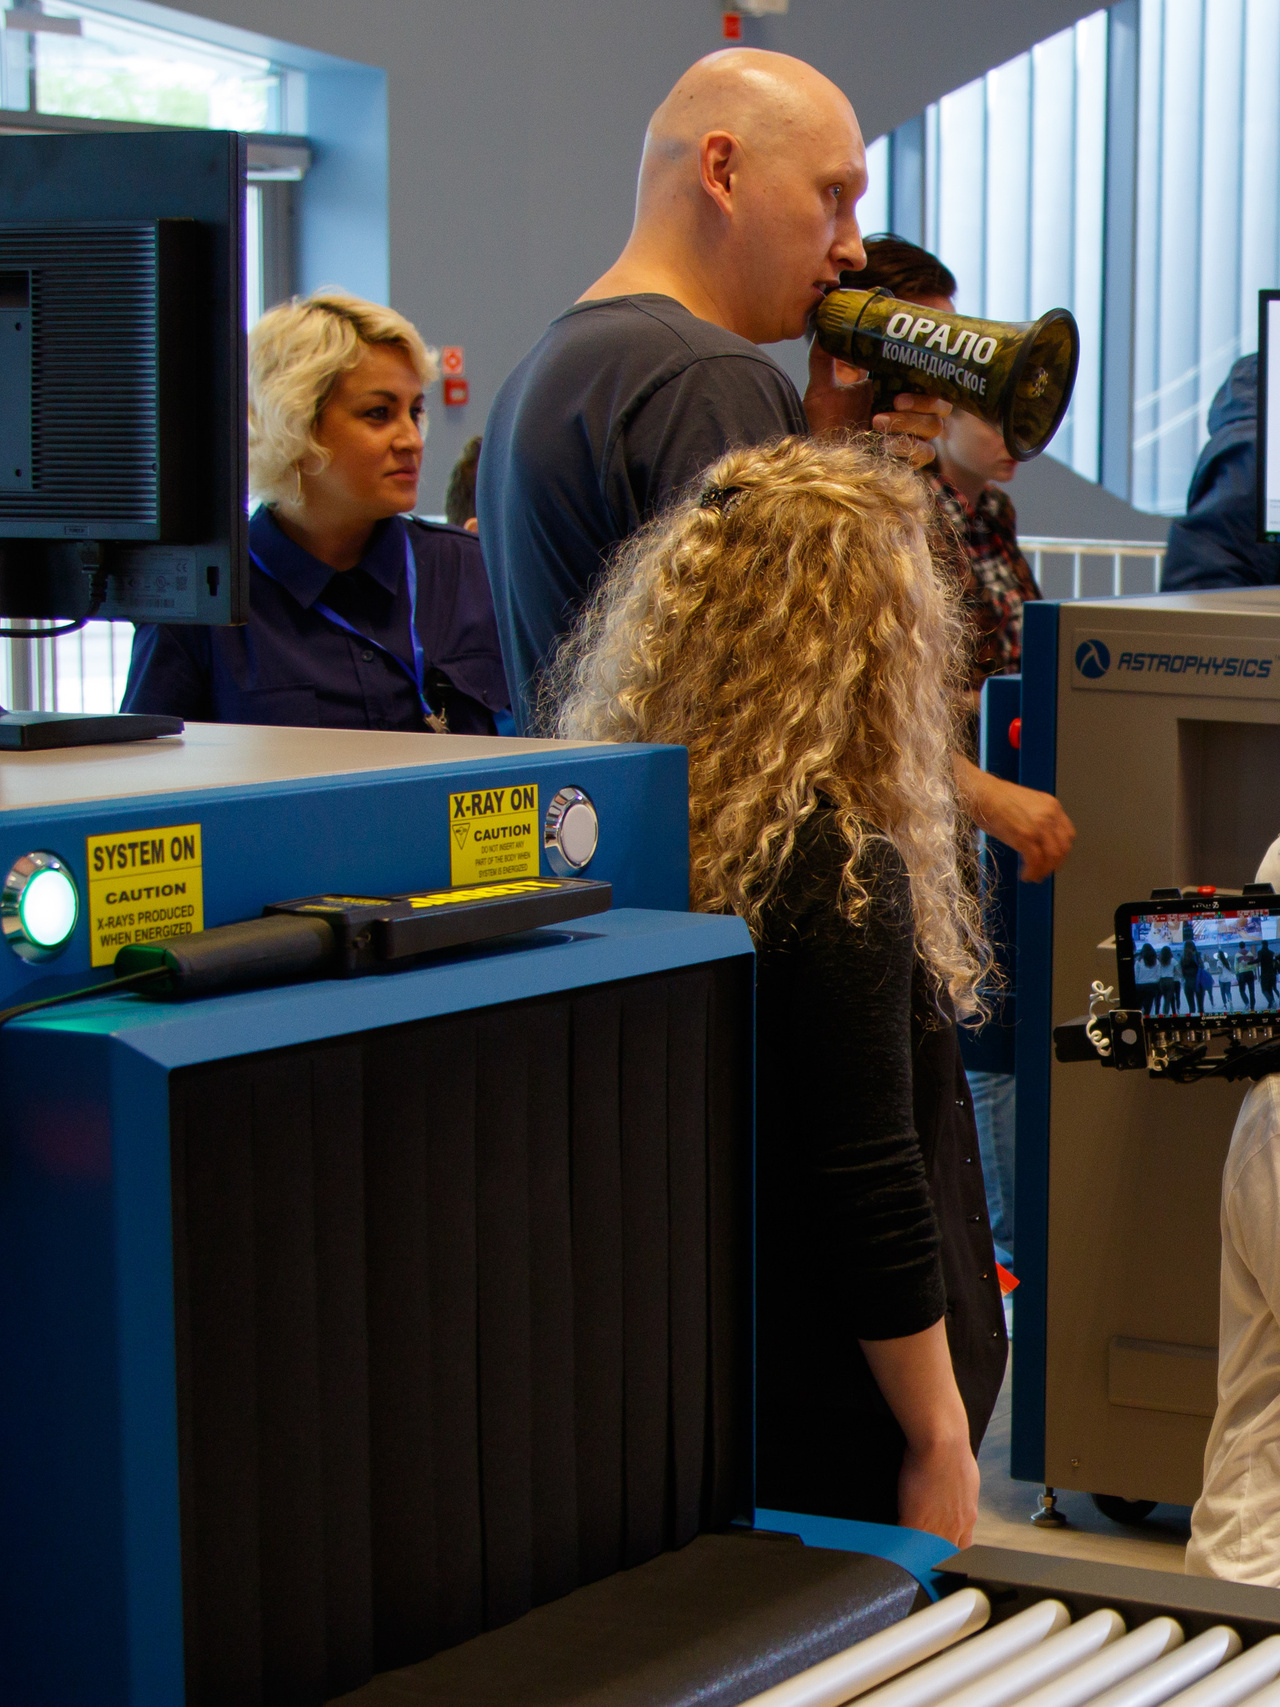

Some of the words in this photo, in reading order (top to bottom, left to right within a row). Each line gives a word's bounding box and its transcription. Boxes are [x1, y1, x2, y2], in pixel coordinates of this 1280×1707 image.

[886, 313, 998, 364] ОРАЛО
[882, 341, 987, 396] КОМАНДИРСКОЕ
[1117, 652, 1273, 678] ASTROPHYSICS
[454, 790, 505, 818] X-RAY
[511, 787, 534, 811] ON
[474, 823, 531, 842] CAUTION
[93, 838, 165, 872] SYSTEM
[170, 835, 195, 861] ON
[475, 858, 487, 866] PART
[488, 856, 495, 865] OF
[495, 855, 503, 863] THE
[504, 853, 517, 862] BODY
[517, 851, 531, 860] WHEN
[481, 846, 489, 854] DO
[489, 843, 499, 852] NOT
[499, 841, 515, 851] INSERT
[479, 868, 497, 878] SYSTEM
[503, 863, 528, 874] ENERGIZED
[105, 882, 187, 905] CAUTION
[97, 912, 135, 931] X-RAYS
[137, 904, 195, 924] PRODUCED
[100, 930, 132, 948] WHEN
[134, 921, 193, 940] ENERGIZED
